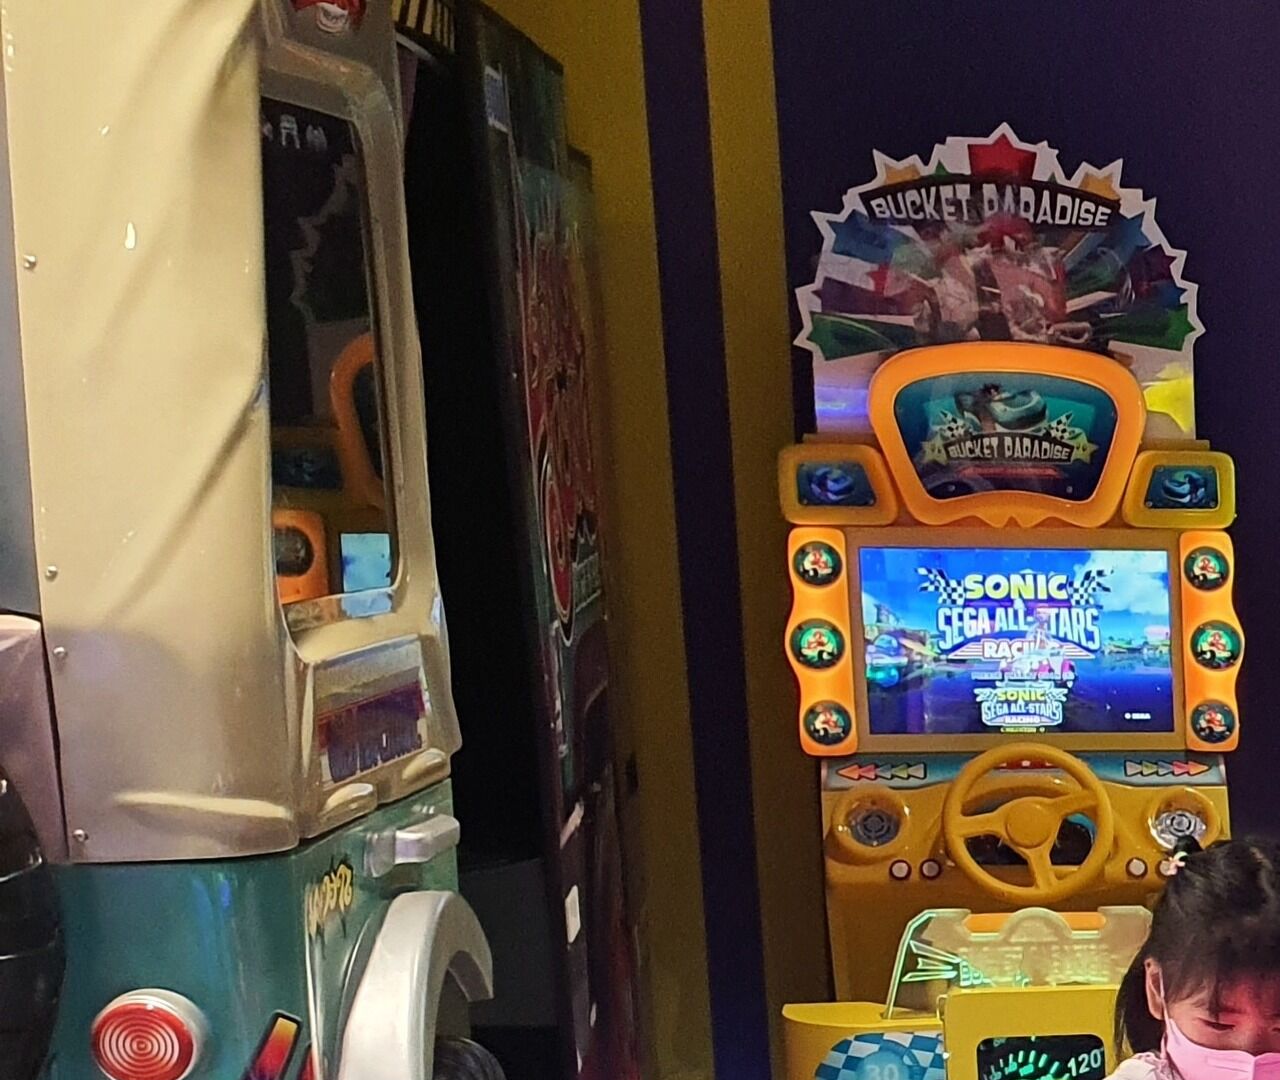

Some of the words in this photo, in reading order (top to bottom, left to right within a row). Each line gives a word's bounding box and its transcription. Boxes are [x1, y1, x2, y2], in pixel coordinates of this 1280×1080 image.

[870, 183, 971, 221] BUCKET
[982, 183, 1112, 227] PARADISE
[948, 437, 998, 459] BUCKET
[1004, 436, 1070, 460] PARADISE
[964, 574, 1069, 600] SONIC
[938, 607, 991, 650] SEGA
[994, 607, 1101, 650] ALL-TARS
[997, 689, 1046, 702] SONIC
[982, 701, 1008, 721] SEGA
[1010, 701, 1062, 721] ALL-STARS
